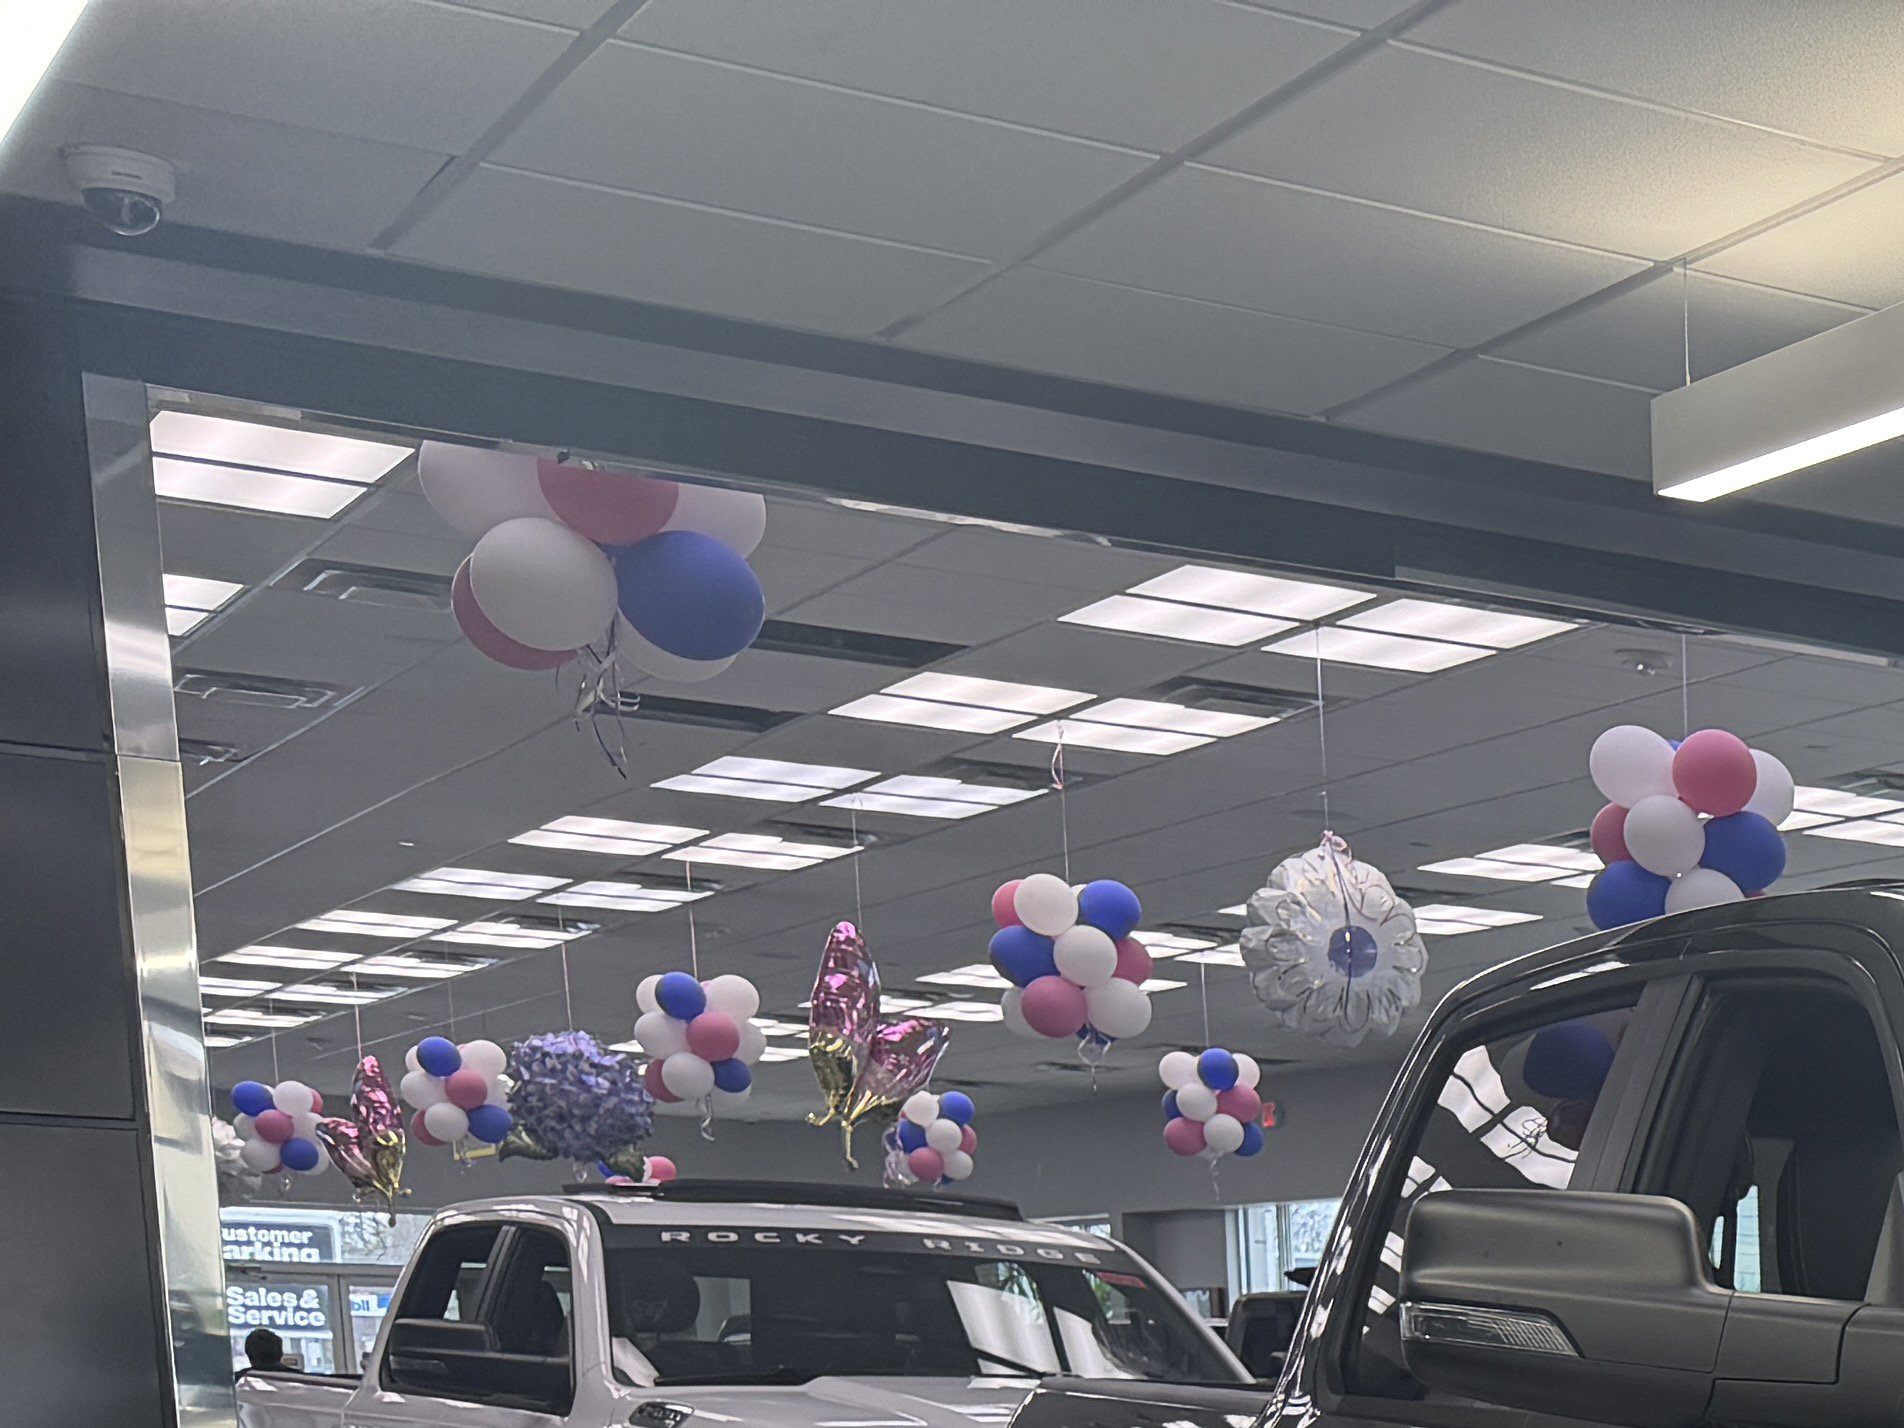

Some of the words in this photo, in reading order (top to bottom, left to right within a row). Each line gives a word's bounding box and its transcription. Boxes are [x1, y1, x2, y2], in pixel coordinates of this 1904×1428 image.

[221, 1226, 313, 1244] ustomer
[222, 1241, 320, 1263] arking
[660, 1230, 868, 1246] ROCKY
[922, 1237, 1104, 1265] RIDGE
[226, 1286, 298, 1308] Sales
[299, 1289, 320, 1309] &
[227, 1306, 326, 1327] Service
